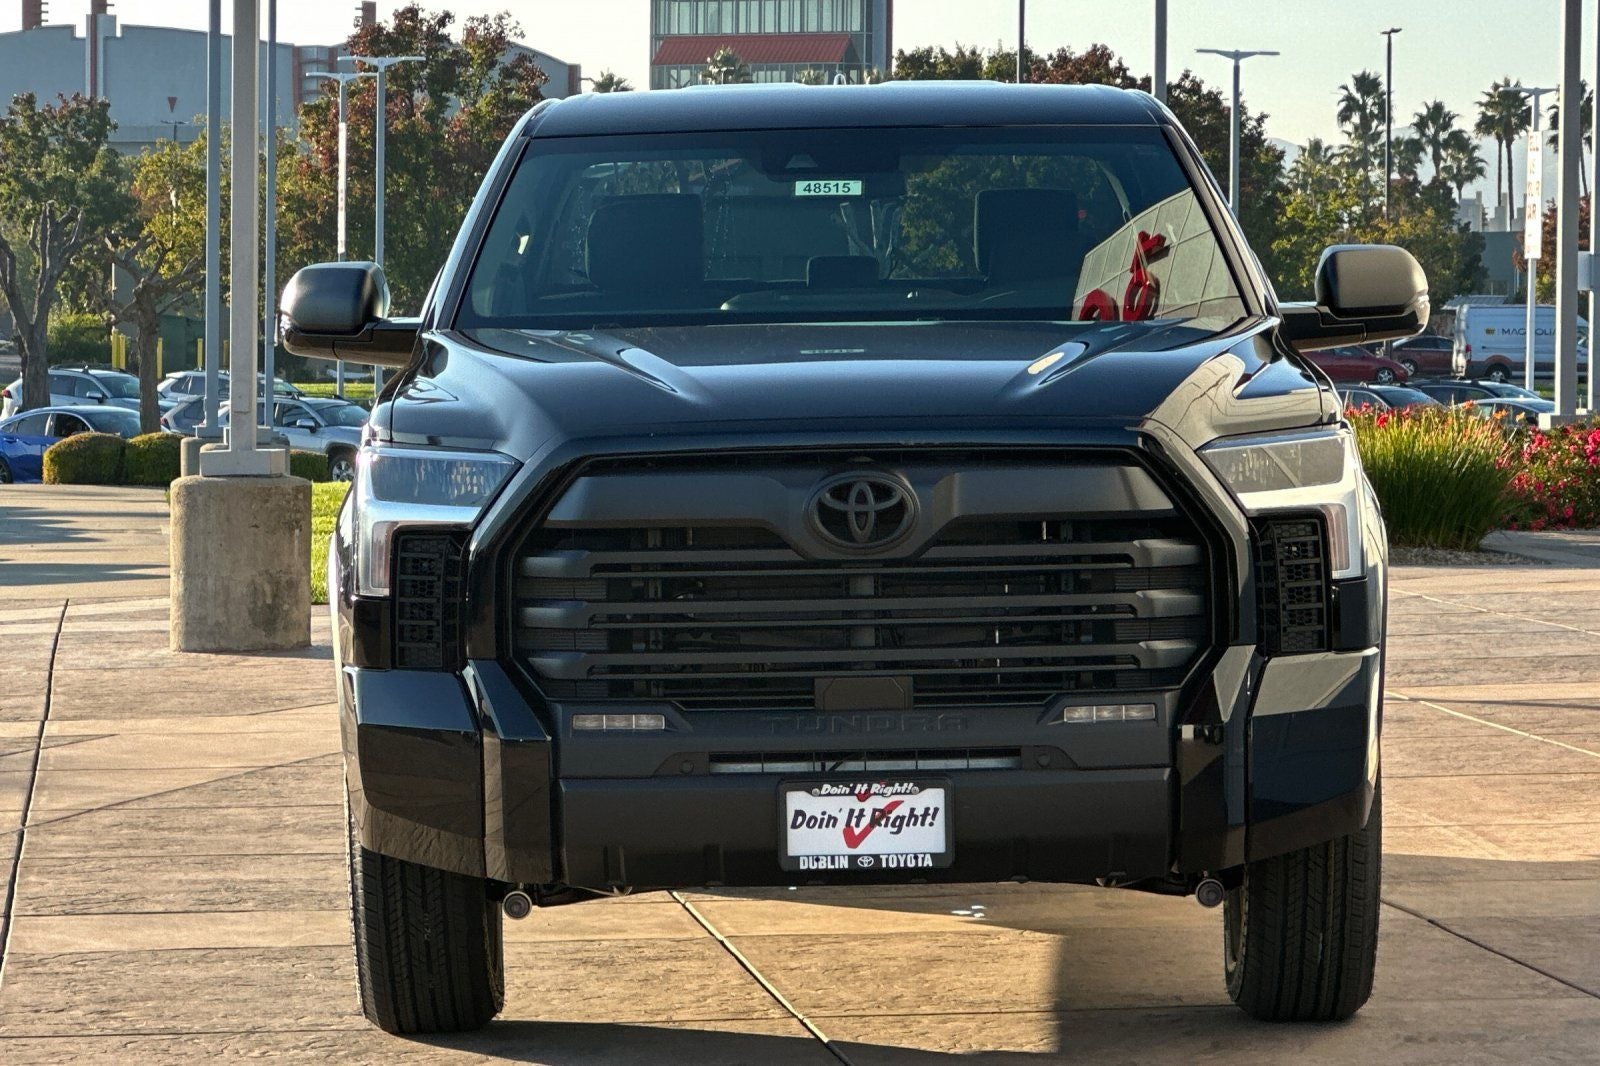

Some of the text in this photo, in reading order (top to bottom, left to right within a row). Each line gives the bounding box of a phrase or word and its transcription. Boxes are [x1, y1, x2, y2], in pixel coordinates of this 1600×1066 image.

[803, 182, 851, 194] 48515
[761, 714, 968, 734] TUNDRA
[820, 782, 913, 797] Doin' It Right!
[790, 806, 940, 835] Doin' It Right!
[800, 853, 933, 870] DUBLIN TOYOTA
